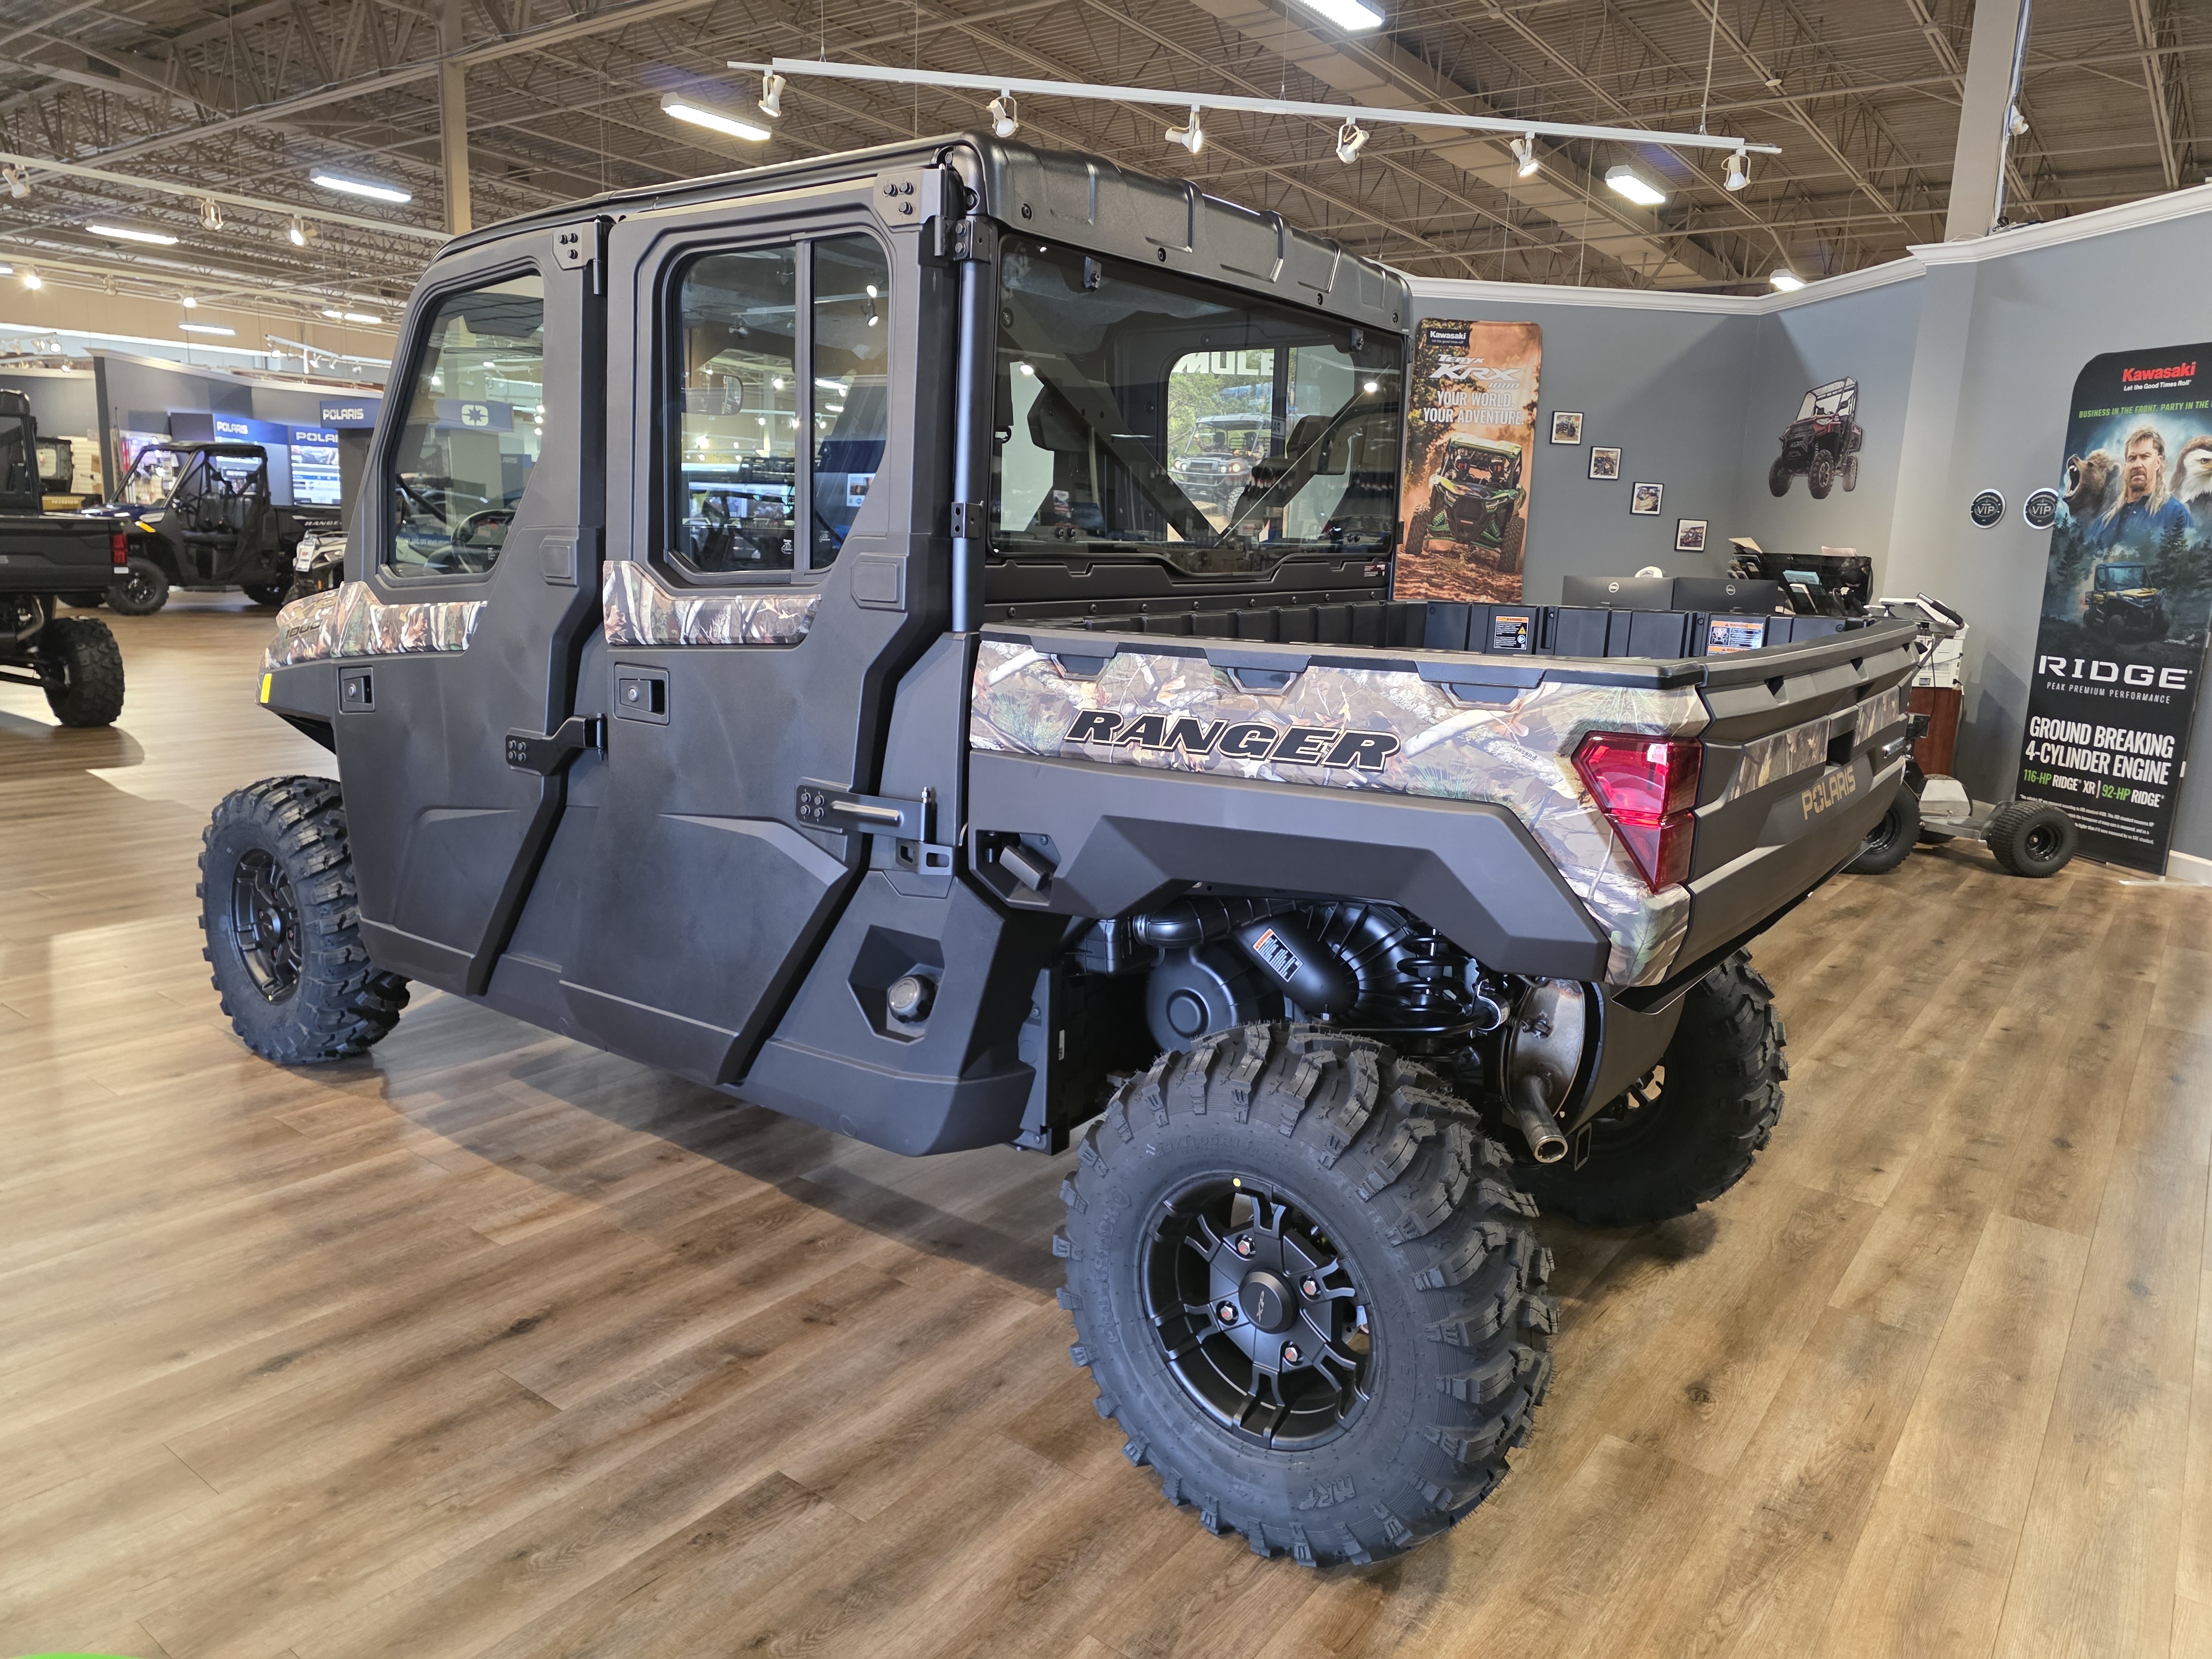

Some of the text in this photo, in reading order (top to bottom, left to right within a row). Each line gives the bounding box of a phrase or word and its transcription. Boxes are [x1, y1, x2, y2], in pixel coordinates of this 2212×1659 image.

[1430, 330, 1466, 340] Kawasaki
[1429, 363, 1522, 381] KRX
[2122, 362, 2197, 382] Kawasaki
[1437, 391, 1514, 408] YOUR WORLD.
[323, 408, 363, 420] POLARIS
[1423, 407, 1524, 425] YOUR ADVENTURE.
[2079, 408, 2110, 419] BUSINESS
[2121, 406, 2133, 414] THE
[2135, 404, 2158, 414] FRONT.
[2161, 402, 2184, 411] PARTY
[2185, 401, 2194, 410] IN
[2195, 400, 2209, 409] THE
[216, 421, 248, 435] POLARIS
[1977, 505, 1995, 514] VIP
[2032, 505, 2051, 515] VIP
[285, 619, 324, 639] 1000
[2038, 655, 2188, 690] RIDGE
[2047, 681, 2171, 704] PEAK PREMIUM PERFORMANCE
[1063, 708, 1401, 773] RANGER
[2030, 716, 2175, 759] GROUND BREAKING
[1512, 745, 1537, 760] PURSUIT
[2025, 740, 2171, 785] 4-CYLINDER ENGINE
[1801, 765, 1856, 820] POLARIS
[2023, 769, 2052, 785] 116-HP
[2082, 780, 2096, 795] XR
[2101, 784, 2131, 801] 92-HP
